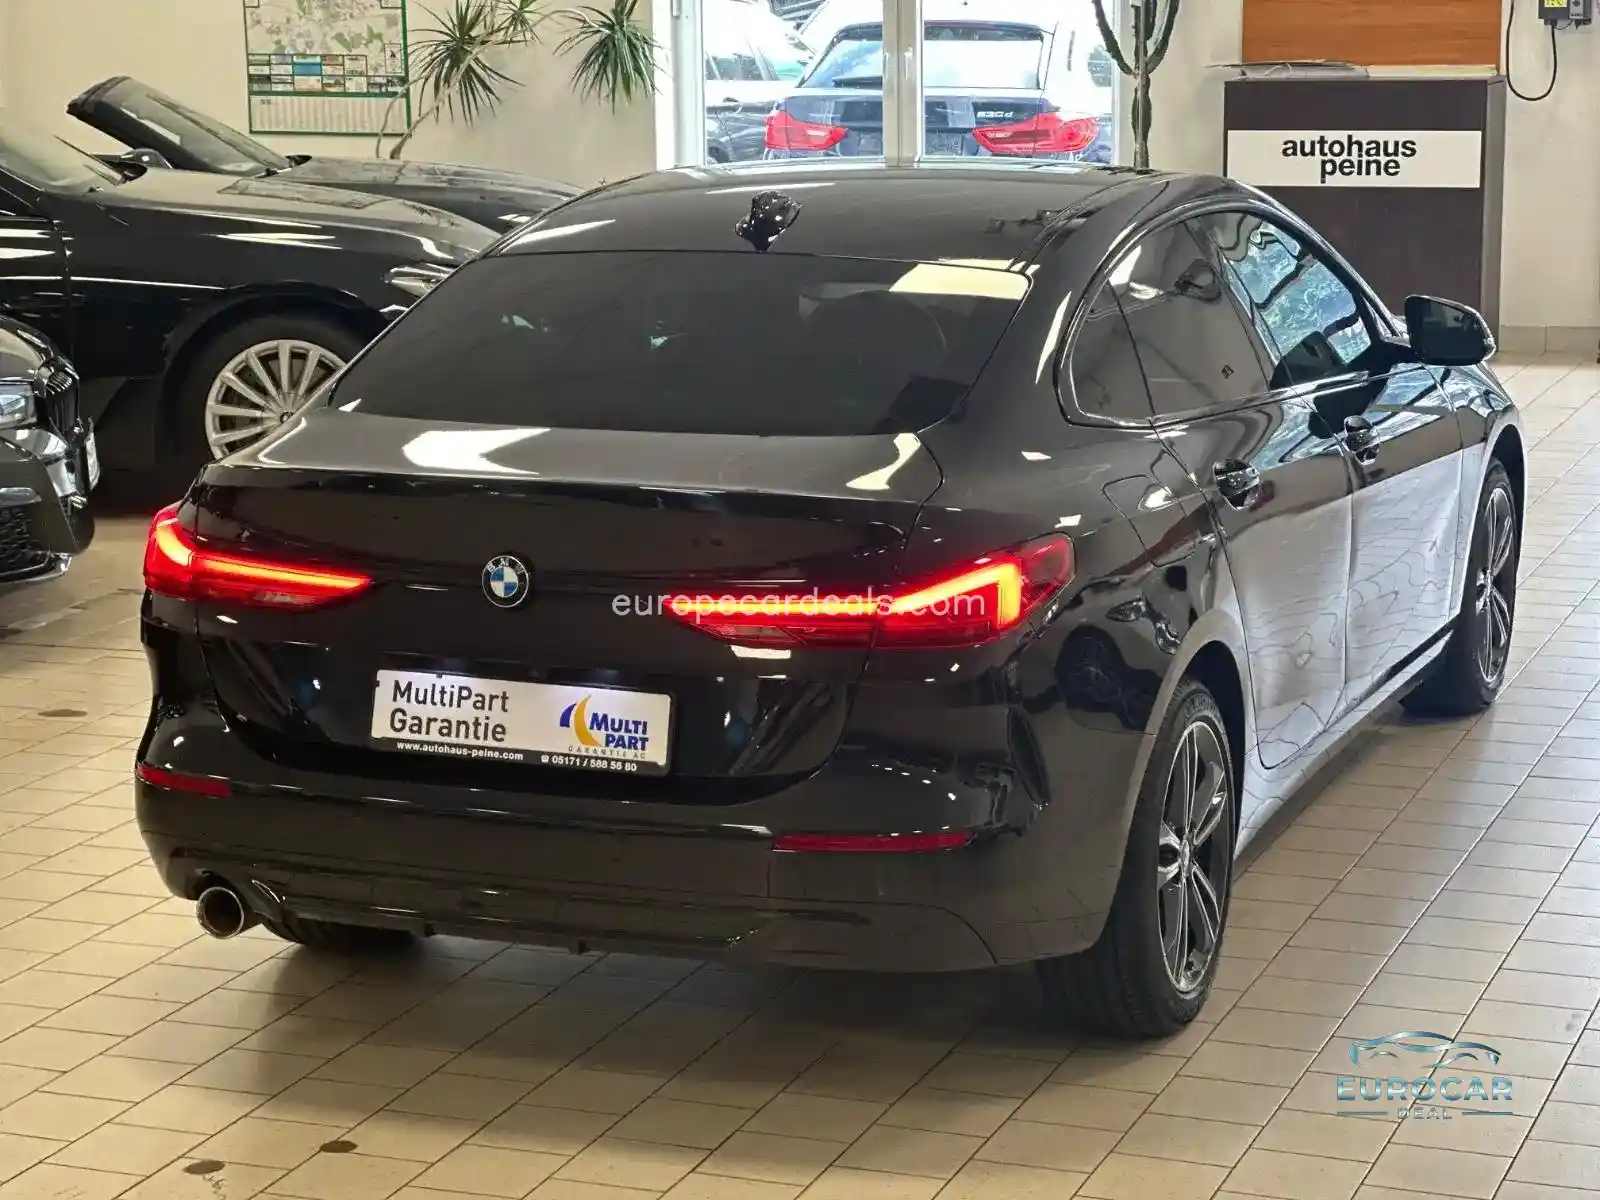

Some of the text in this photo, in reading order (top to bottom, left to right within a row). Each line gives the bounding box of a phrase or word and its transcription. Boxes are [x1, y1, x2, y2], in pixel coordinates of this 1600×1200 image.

[1282, 134, 1417, 157] autohaus
[1320, 152, 1401, 184] peine
[392, 679, 510, 713] MultiPart
[389, 707, 507, 742] Garantie
[589, 712, 648, 735] MULTI
[396, 741, 524, 761] www.autohaus-peine.com
[605, 733, 649, 751] PART
[552, 755, 580, 766] 05171
